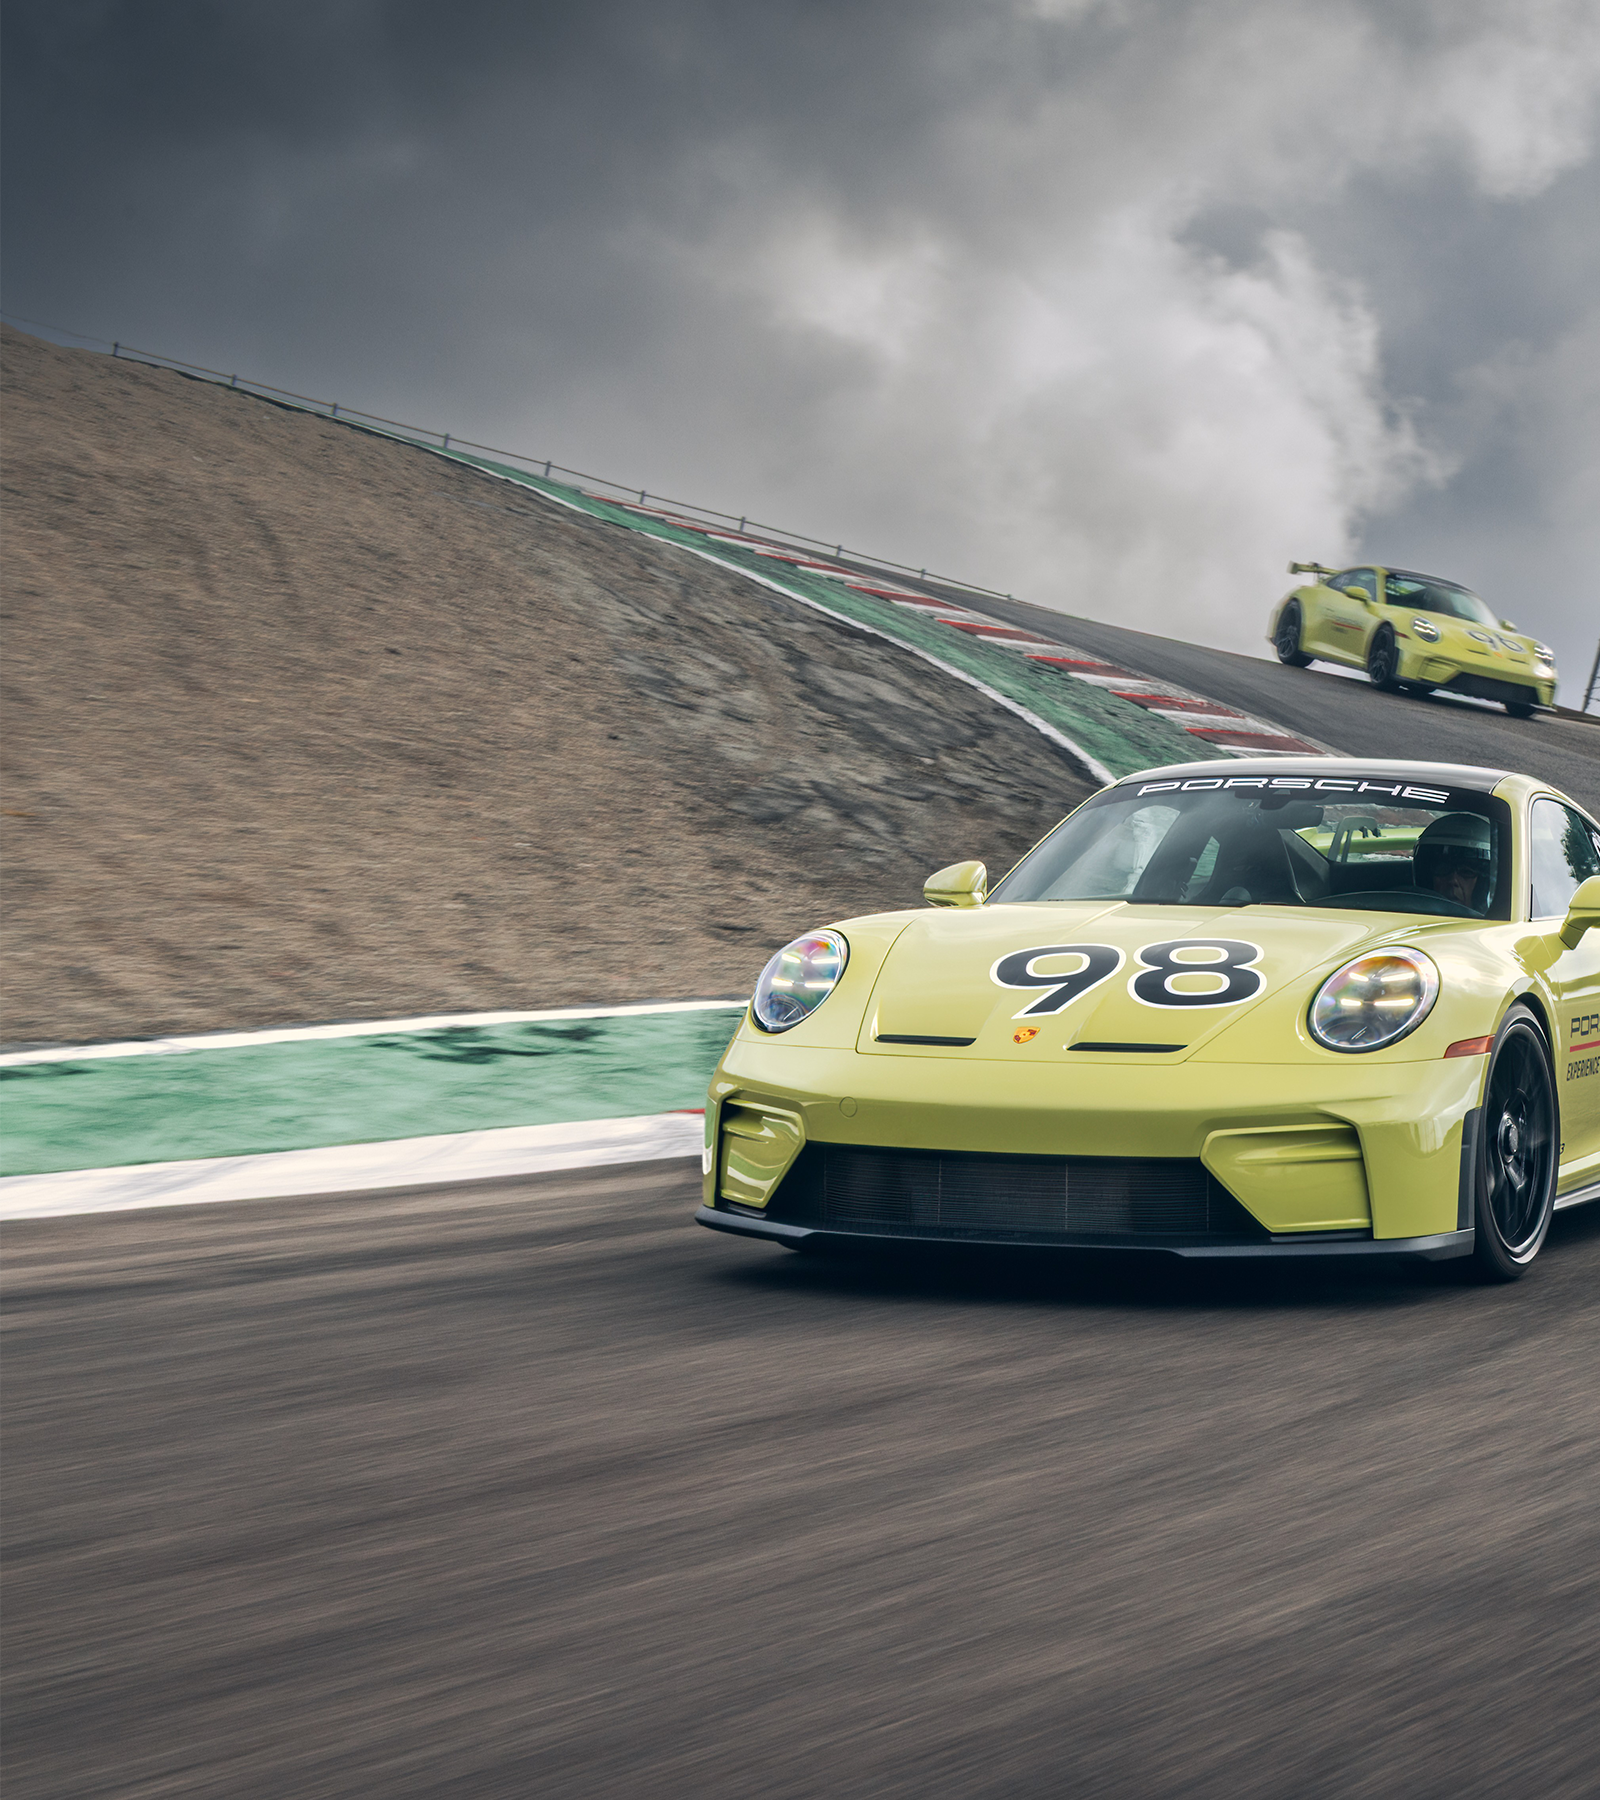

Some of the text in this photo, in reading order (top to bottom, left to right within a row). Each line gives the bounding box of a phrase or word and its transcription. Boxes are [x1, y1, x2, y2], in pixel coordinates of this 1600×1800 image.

[1136, 777, 1450, 804] PORSCHE
[989, 938, 1267, 1020] 98
[1566, 1056, 1600, 1081] EXPERIENCE
